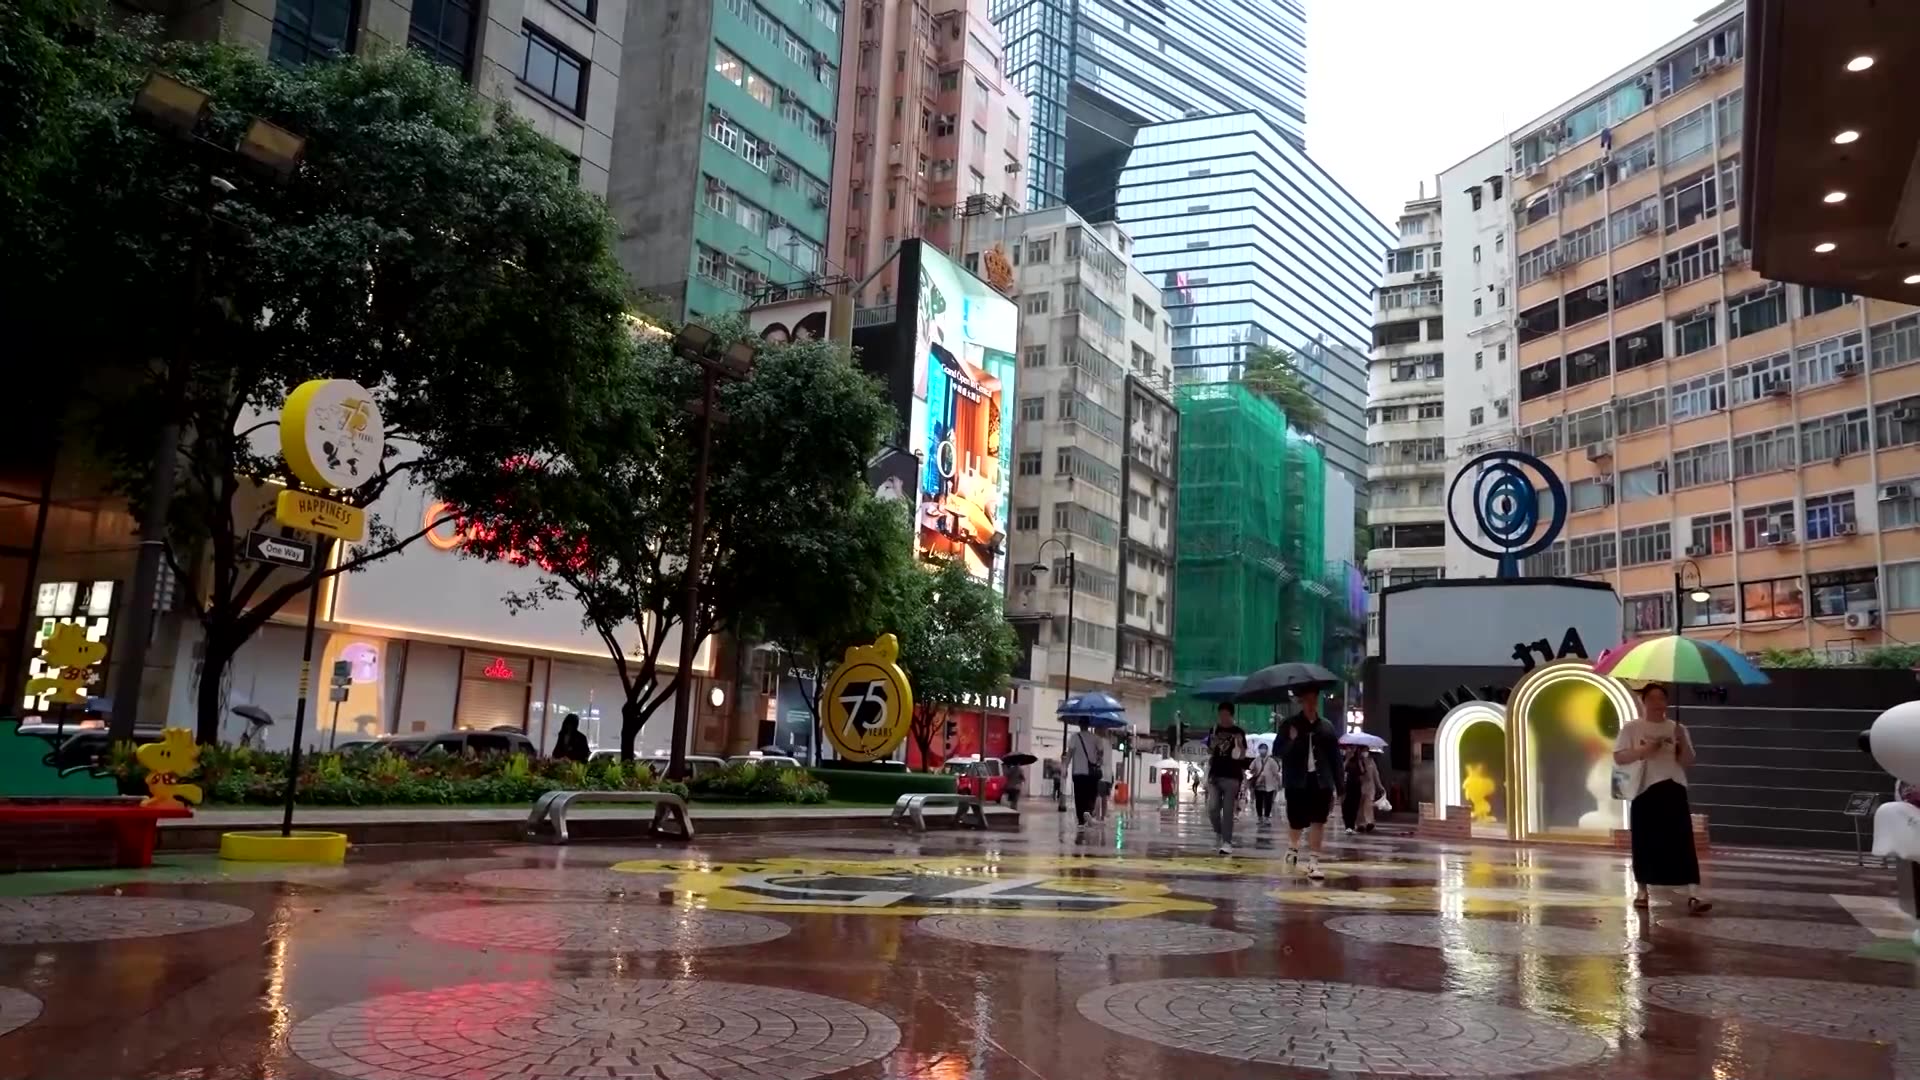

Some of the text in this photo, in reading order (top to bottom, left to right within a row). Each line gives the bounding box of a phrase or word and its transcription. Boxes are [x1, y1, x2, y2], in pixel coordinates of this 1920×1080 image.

[298, 499, 352, 525] HAPPINESS
[265, 543, 302, 561] One Way
[483, 666, 513, 679] OMEGA
[838, 680, 888, 737] 75
[868, 727, 893, 737] YEARS
